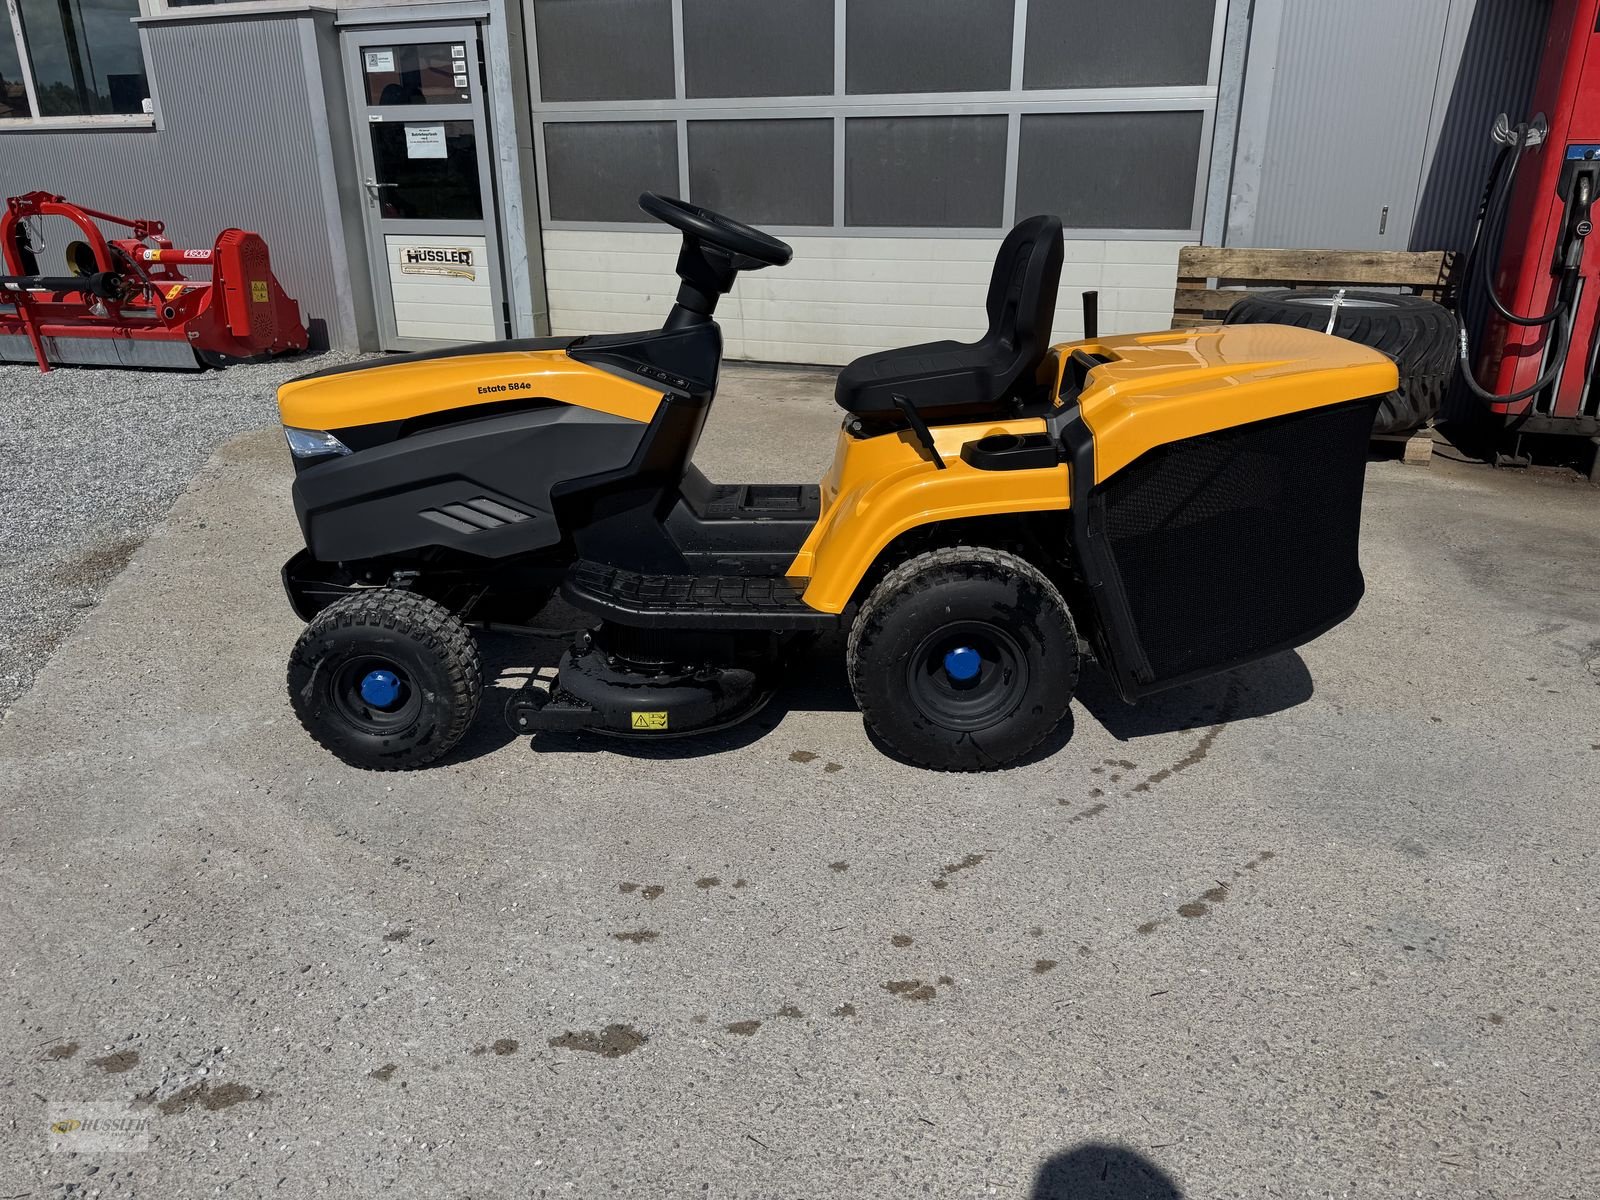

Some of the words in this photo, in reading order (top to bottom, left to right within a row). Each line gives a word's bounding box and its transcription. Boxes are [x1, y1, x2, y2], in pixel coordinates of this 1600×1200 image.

[407, 250, 473, 266] HÜSSLER
[477, 384, 507, 395] Estate
[508, 382, 531, 391] 584e
